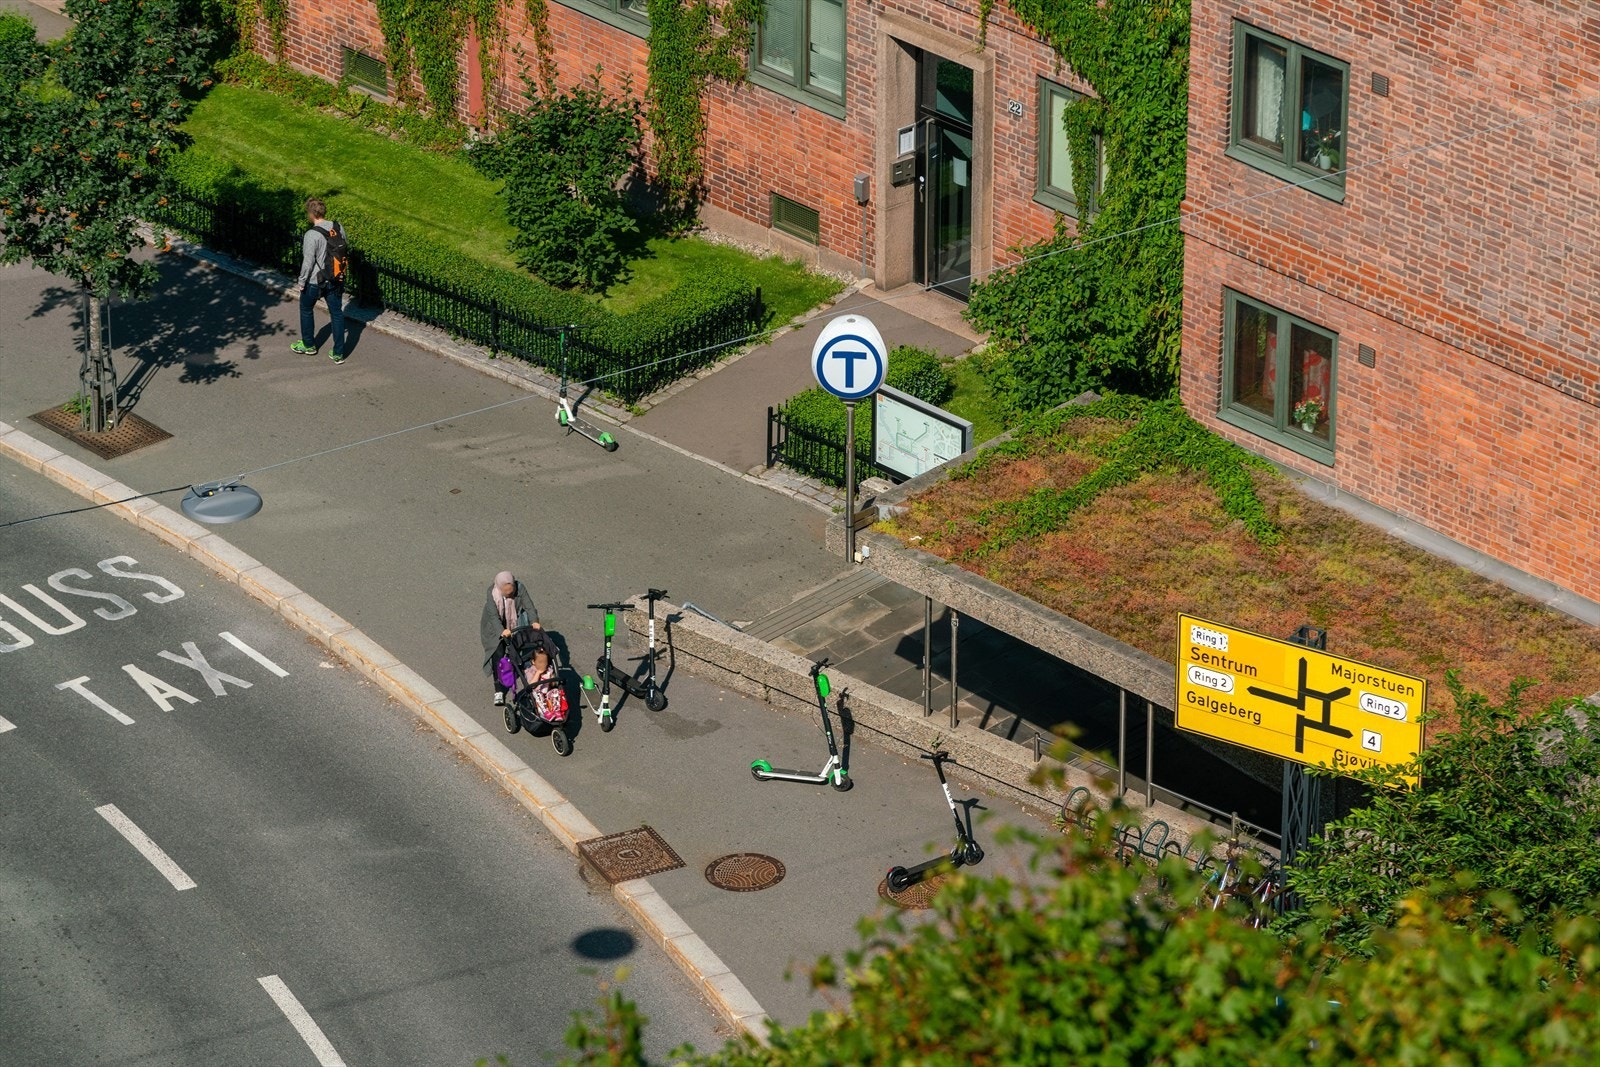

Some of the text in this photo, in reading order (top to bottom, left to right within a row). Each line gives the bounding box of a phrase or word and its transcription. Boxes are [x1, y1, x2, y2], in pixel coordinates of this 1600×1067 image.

[1009, 101, 1021, 115] 22
[832, 351, 867, 388] T
[1196, 631, 1224, 646] Ring 1
[1191, 647, 1257, 677] Sentrum
[54, 631, 290, 726] TAXI
[1194, 670, 1227, 688] Ring 2
[1331, 663, 1415, 697] Majorstuen
[1186, 691, 1262, 725] Galgeberg
[1366, 698, 1400, 715] Ring 2
[1367, 736, 1376, 747] 4
